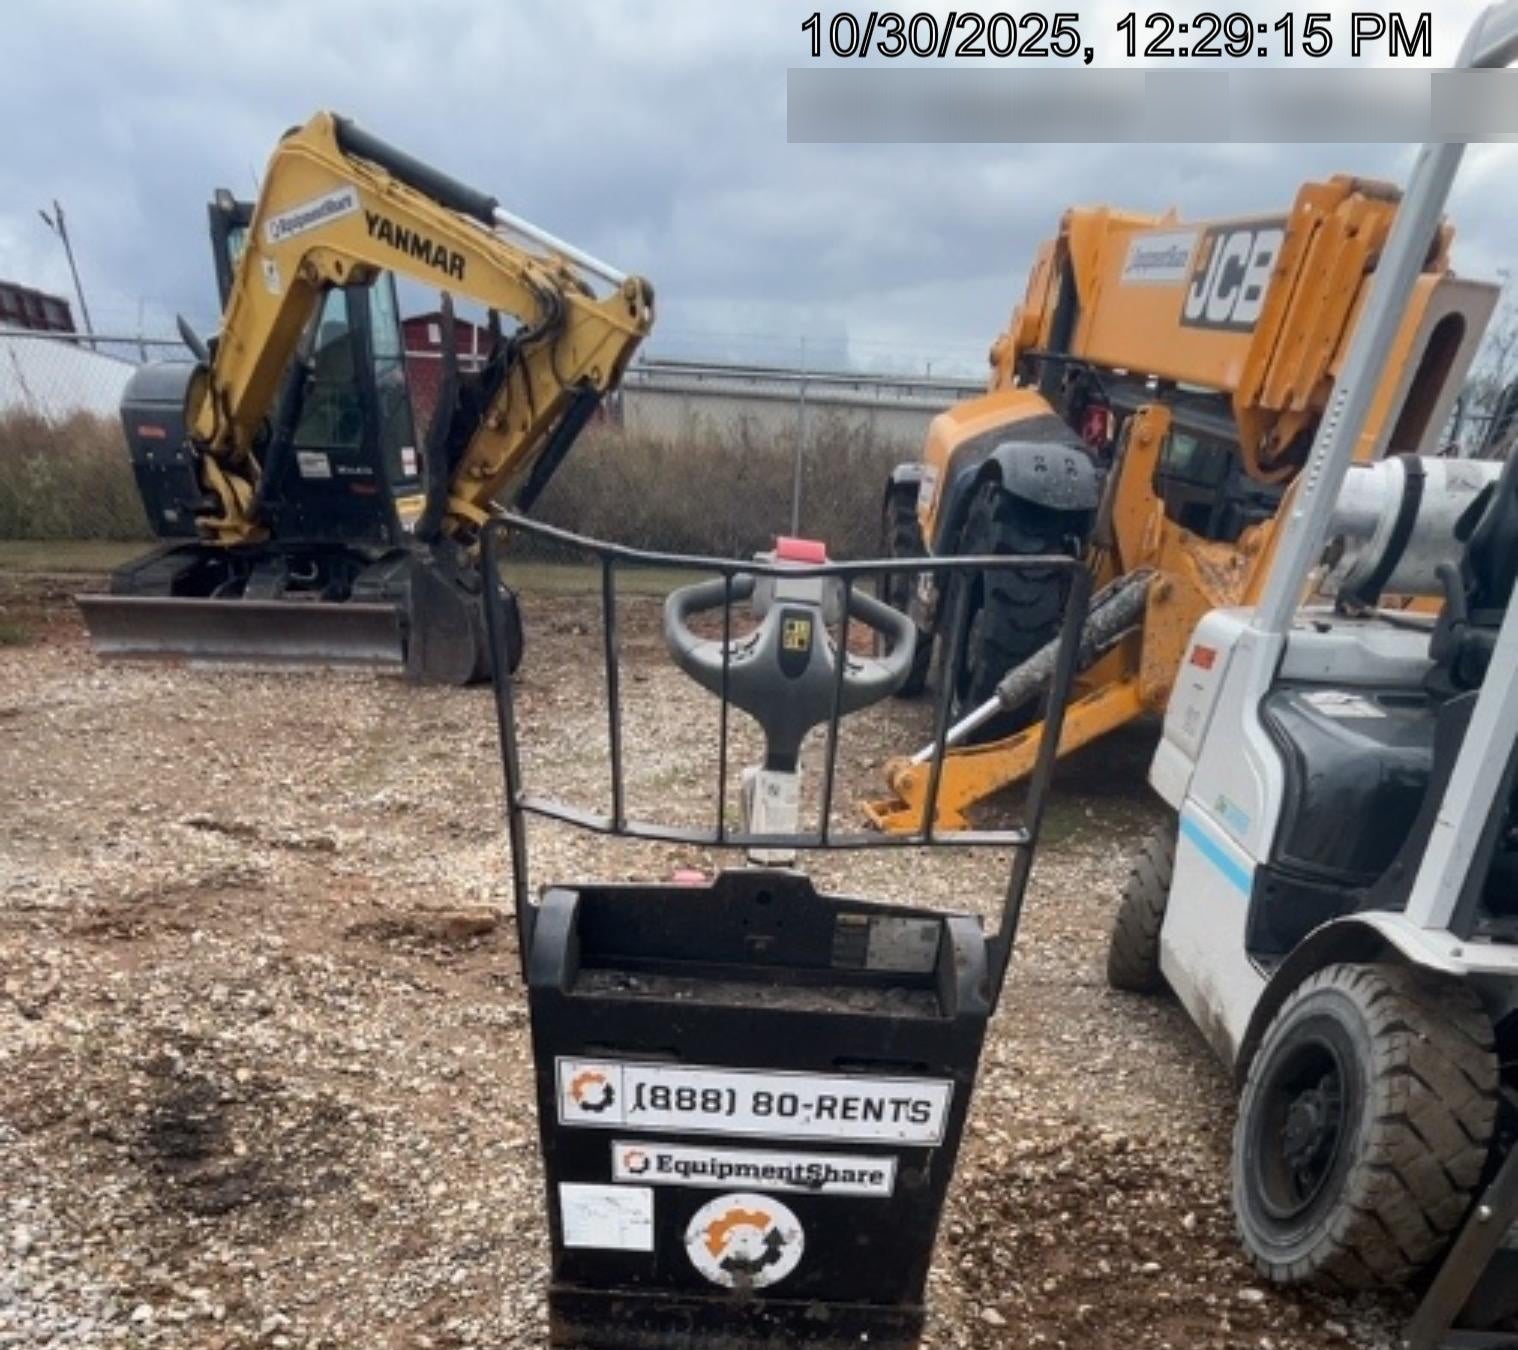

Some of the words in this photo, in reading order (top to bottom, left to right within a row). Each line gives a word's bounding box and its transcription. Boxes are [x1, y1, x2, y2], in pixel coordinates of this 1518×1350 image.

[364, 209, 466, 282] YANMAR
[1185, 229, 1285, 322] JCB
[633, 1081, 736, 1114] (888)
[751, 1090, 932, 1124] 80-RENTS
[655, 1153, 885, 1187] EquipmentShare
